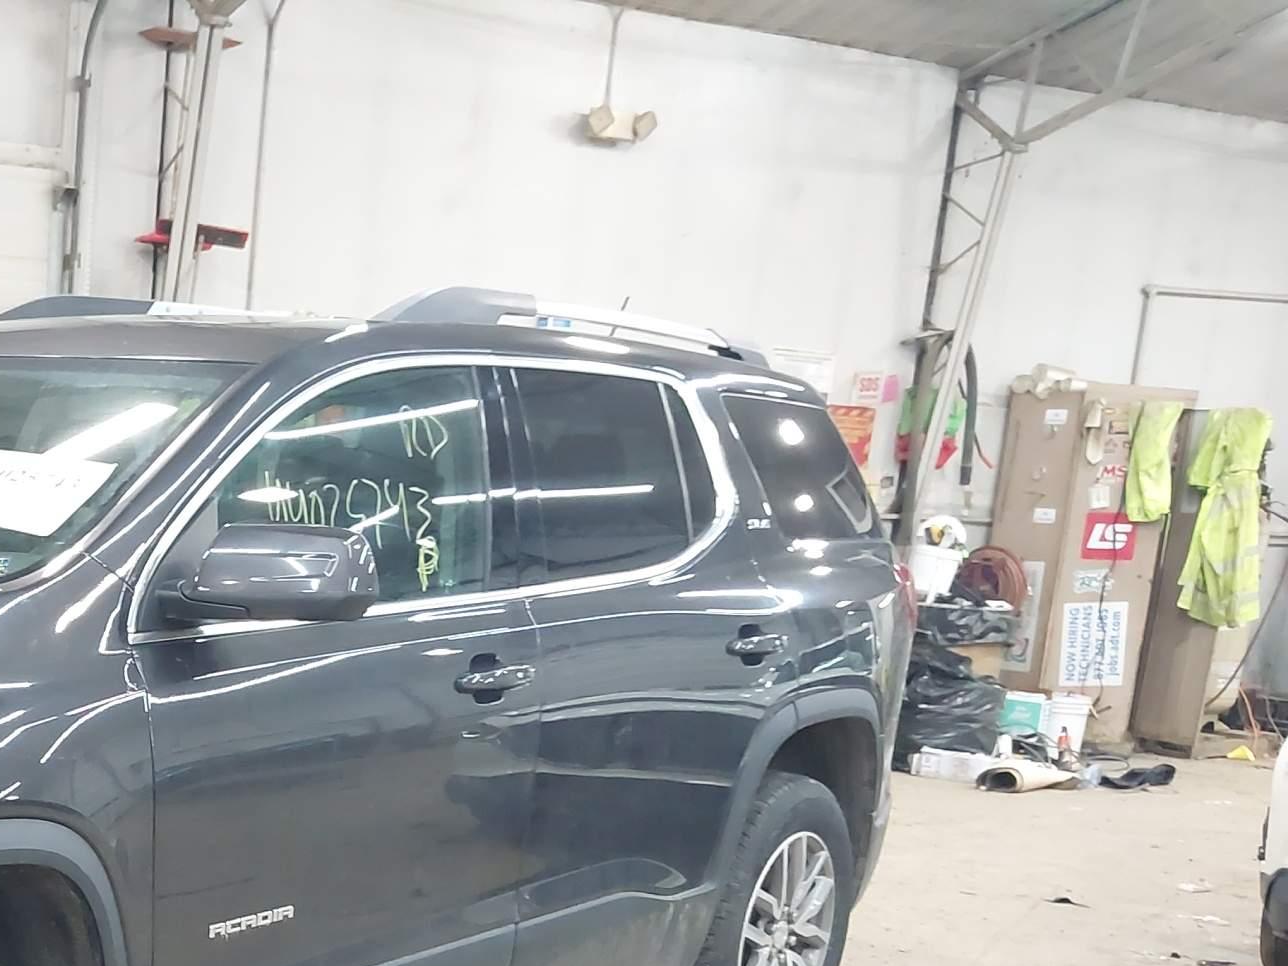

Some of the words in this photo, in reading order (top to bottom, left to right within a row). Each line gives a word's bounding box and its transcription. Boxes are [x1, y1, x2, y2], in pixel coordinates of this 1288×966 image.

[1067, 608, 1080, 648] HIRING
[1078, 605, 1093, 682] TECHNICIANS
[1065, 651, 1077, 681] NOW
[208, 905, 295, 938] ACADIA
